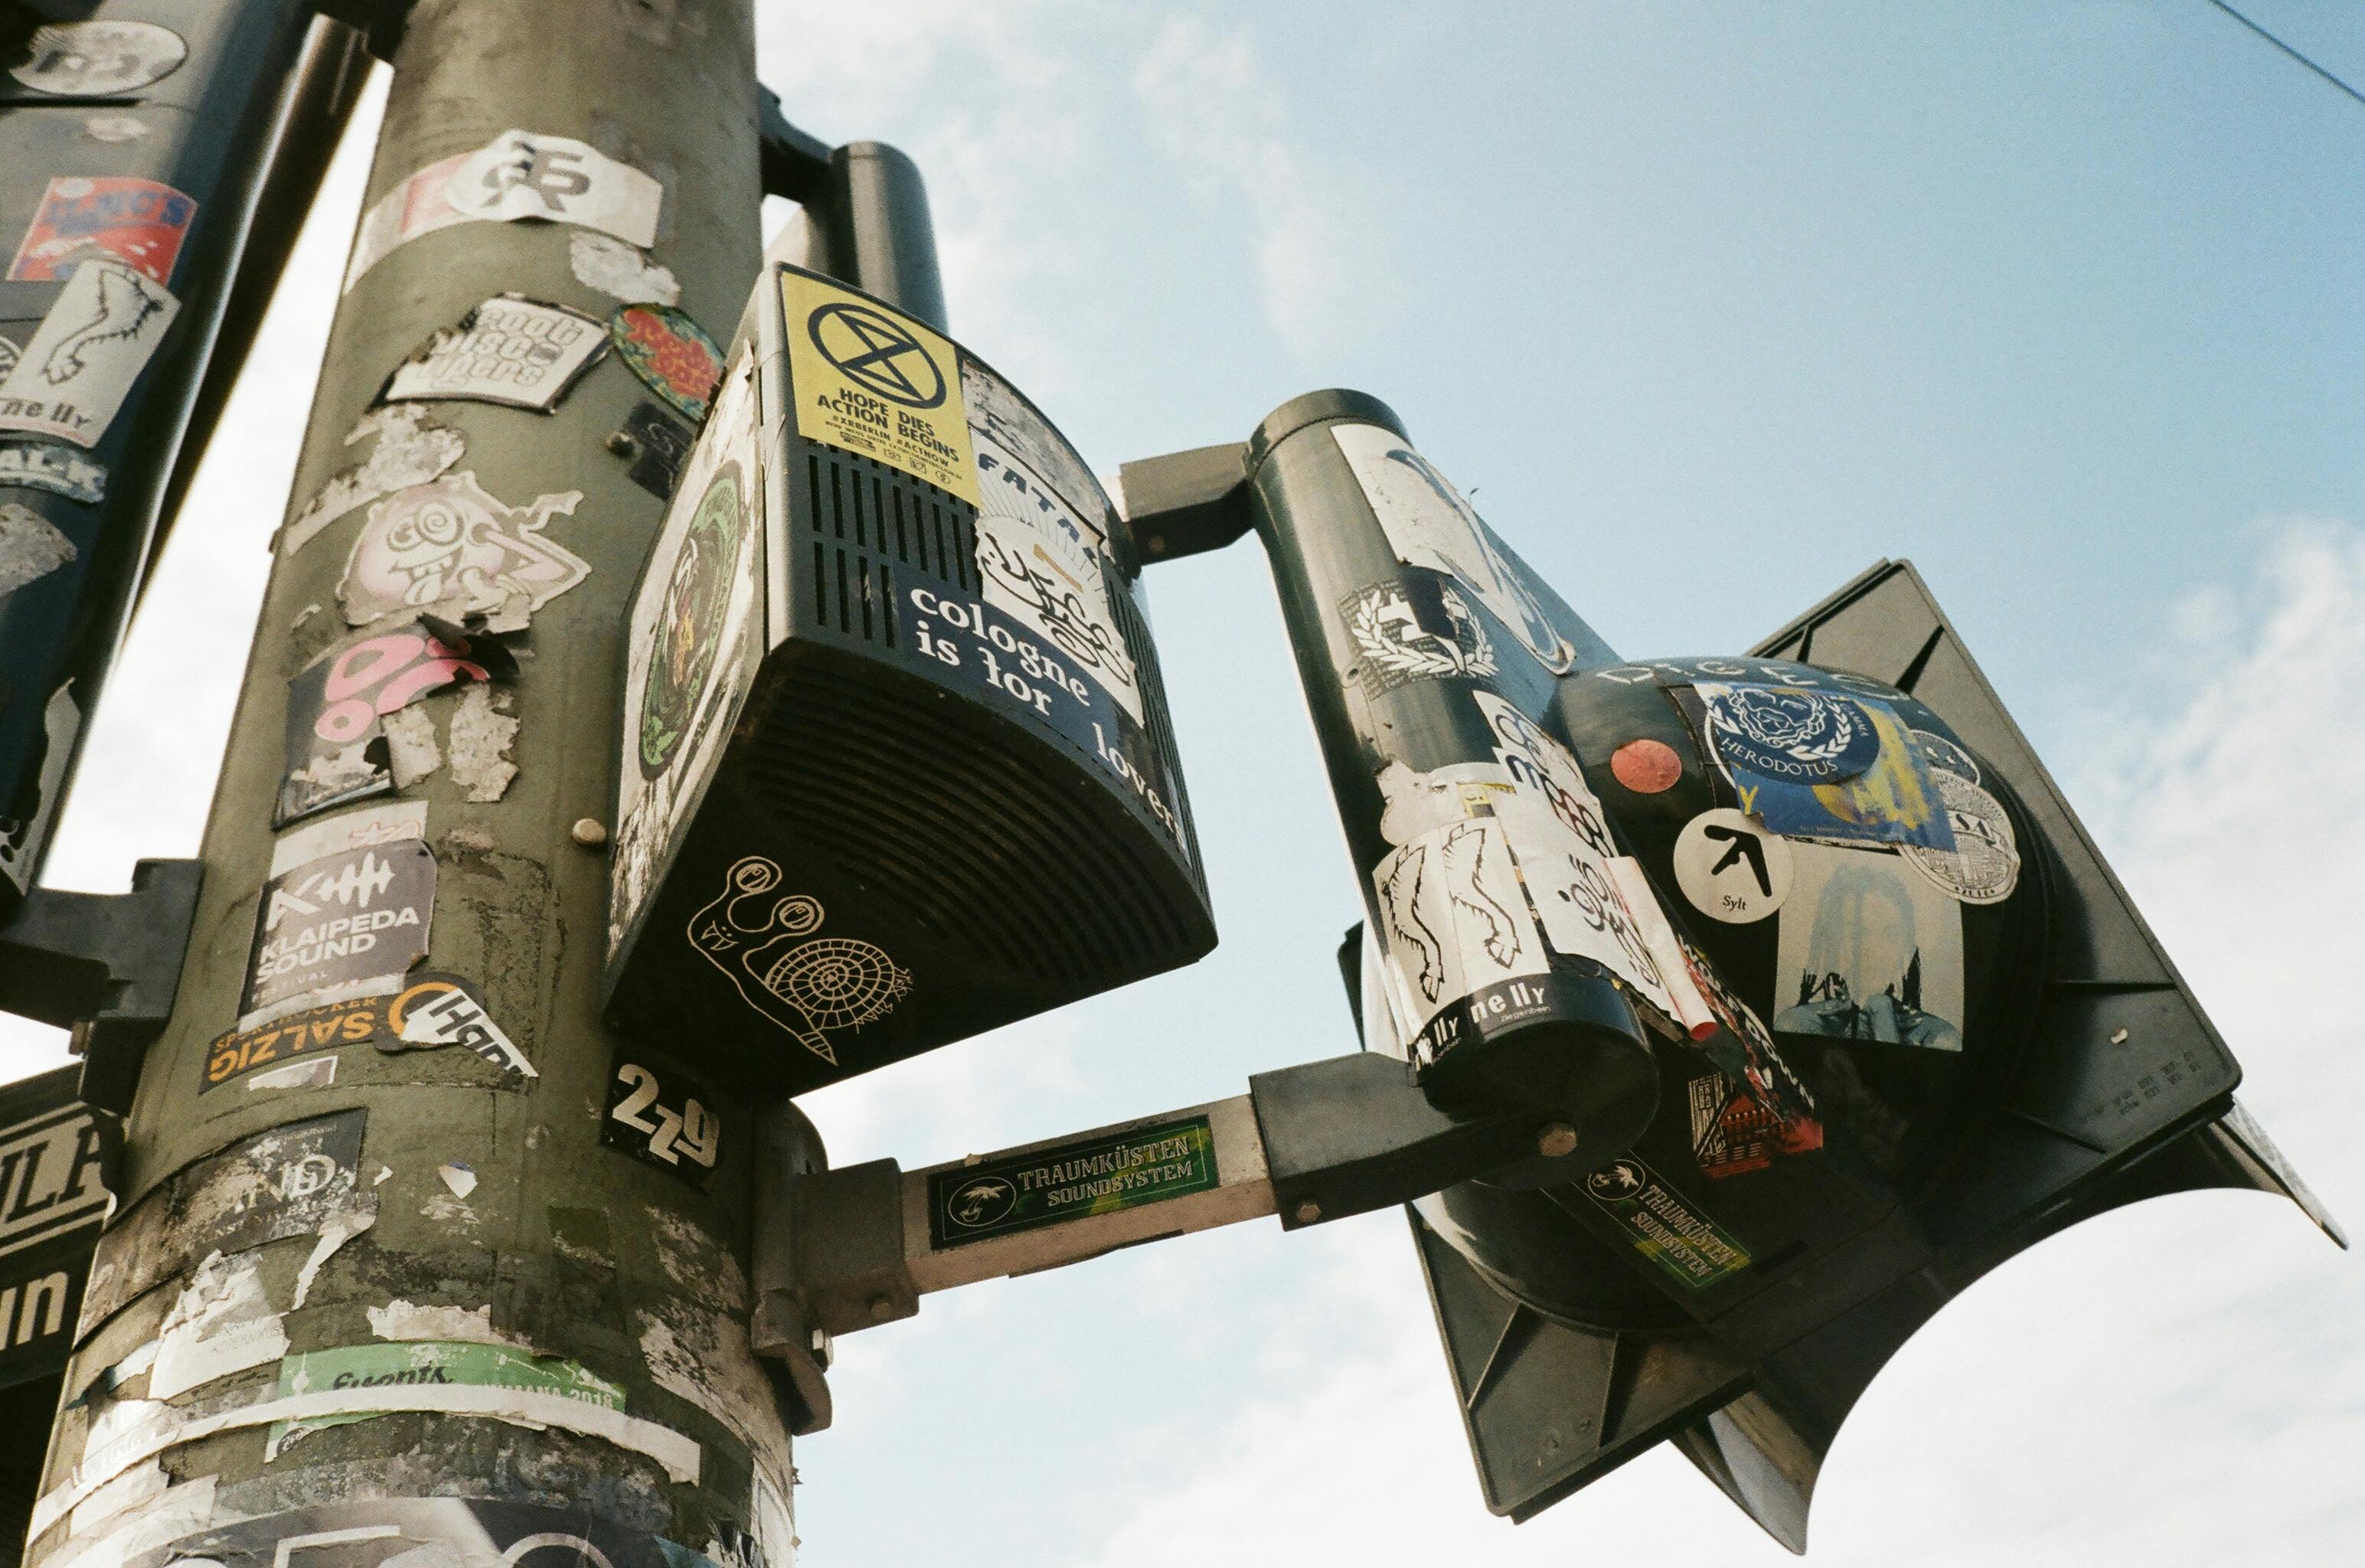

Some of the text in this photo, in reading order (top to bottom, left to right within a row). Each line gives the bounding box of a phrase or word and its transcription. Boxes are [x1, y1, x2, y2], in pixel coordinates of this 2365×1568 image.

[817, 394, 889, 429] ACTION
[897, 423, 960, 462] BEGINS
[840, 388, 935, 437] HOPE DIES
[833, 416, 890, 441] #XRBERLIN
[897, 439, 949, 467] #ACTNOW
[911, 589, 1090, 707] cologne
[916, 621, 1053, 717] is for
[1721, 737, 1838, 777] HERODOTUS
[1722, 893, 1748, 912] Sylt
[256, 933, 377, 985] SOUND
[260, 906, 420, 965] KLAIPEDA
[207, 1013, 376, 1083] SALZIG
[1018, 1136, 1191, 1192] TRAUMKÜSTEN
[1047, 1160, 1194, 1207] SOUNDSYSTEM
[1630, 1211, 1713, 1278] SOUNDSYSTEM
[1638, 1184, 1738, 1266] TRAUMKÜSTEN
